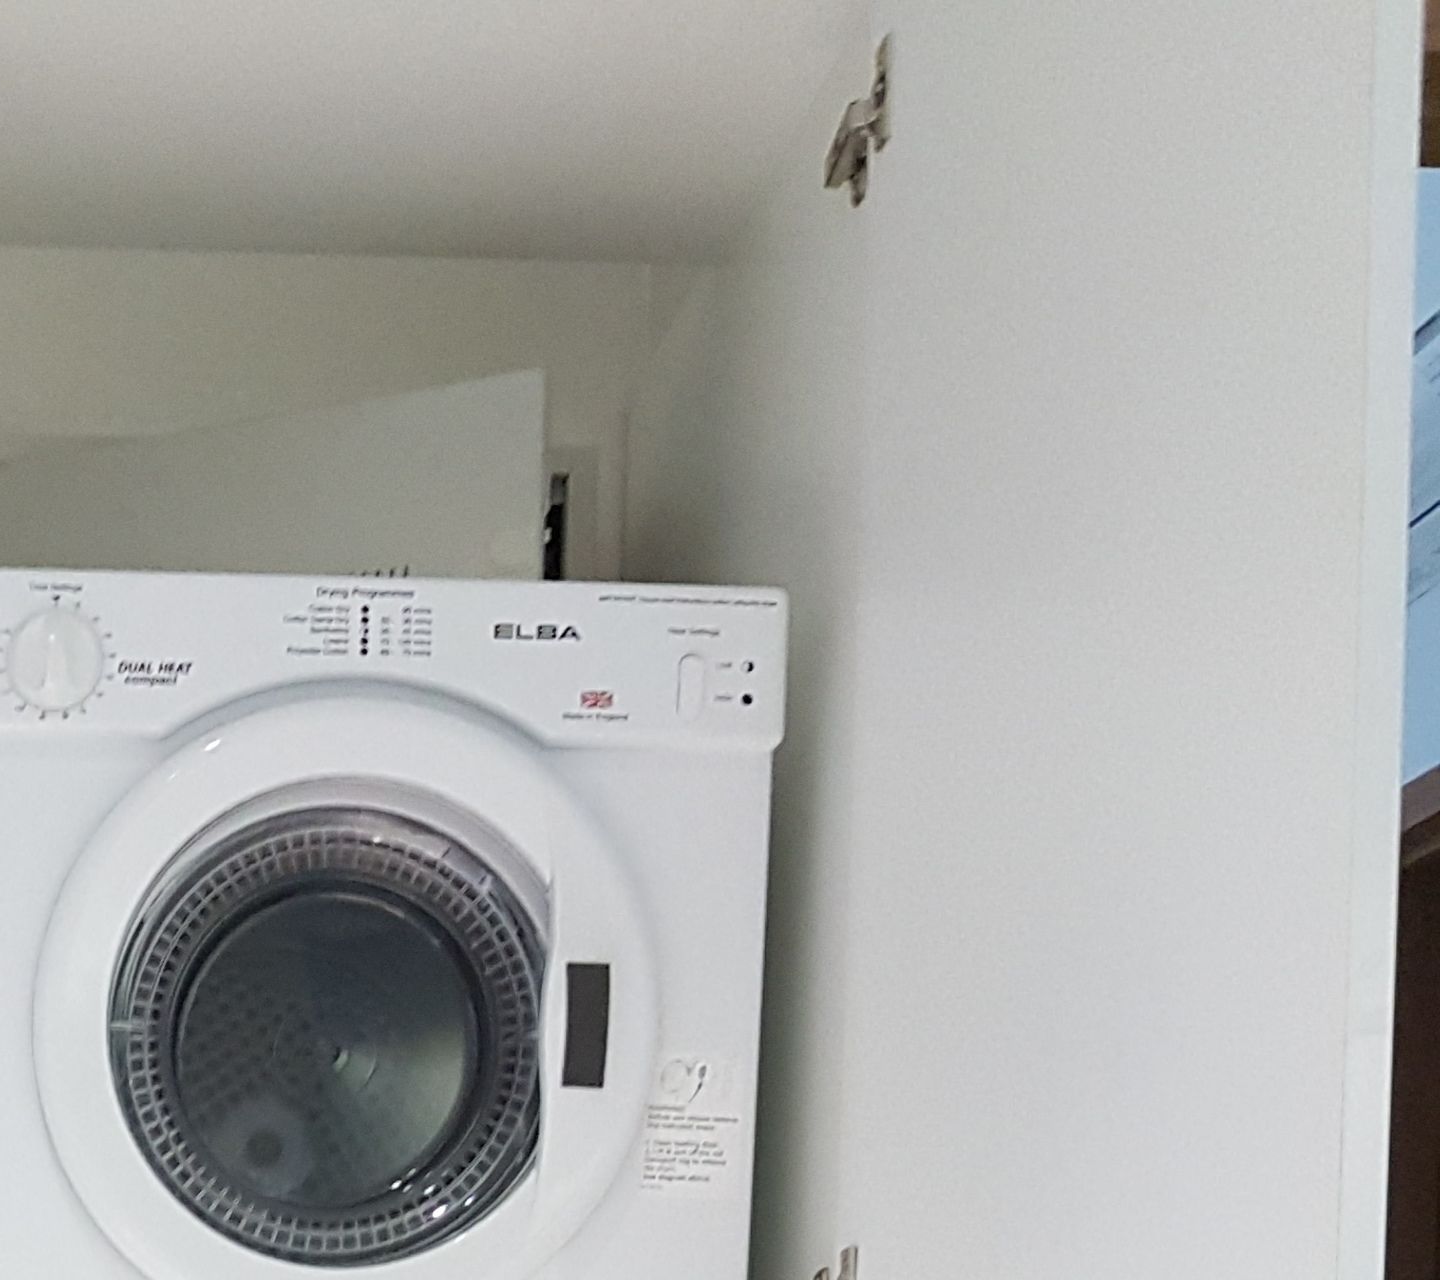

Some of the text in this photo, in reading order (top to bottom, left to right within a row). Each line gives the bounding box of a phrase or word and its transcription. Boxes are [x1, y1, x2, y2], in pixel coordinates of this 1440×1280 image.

[494, 623, 581, 641] ELBA
[117, 662, 193, 675] DUAL HEAT
[124, 674, 178, 687] compact
